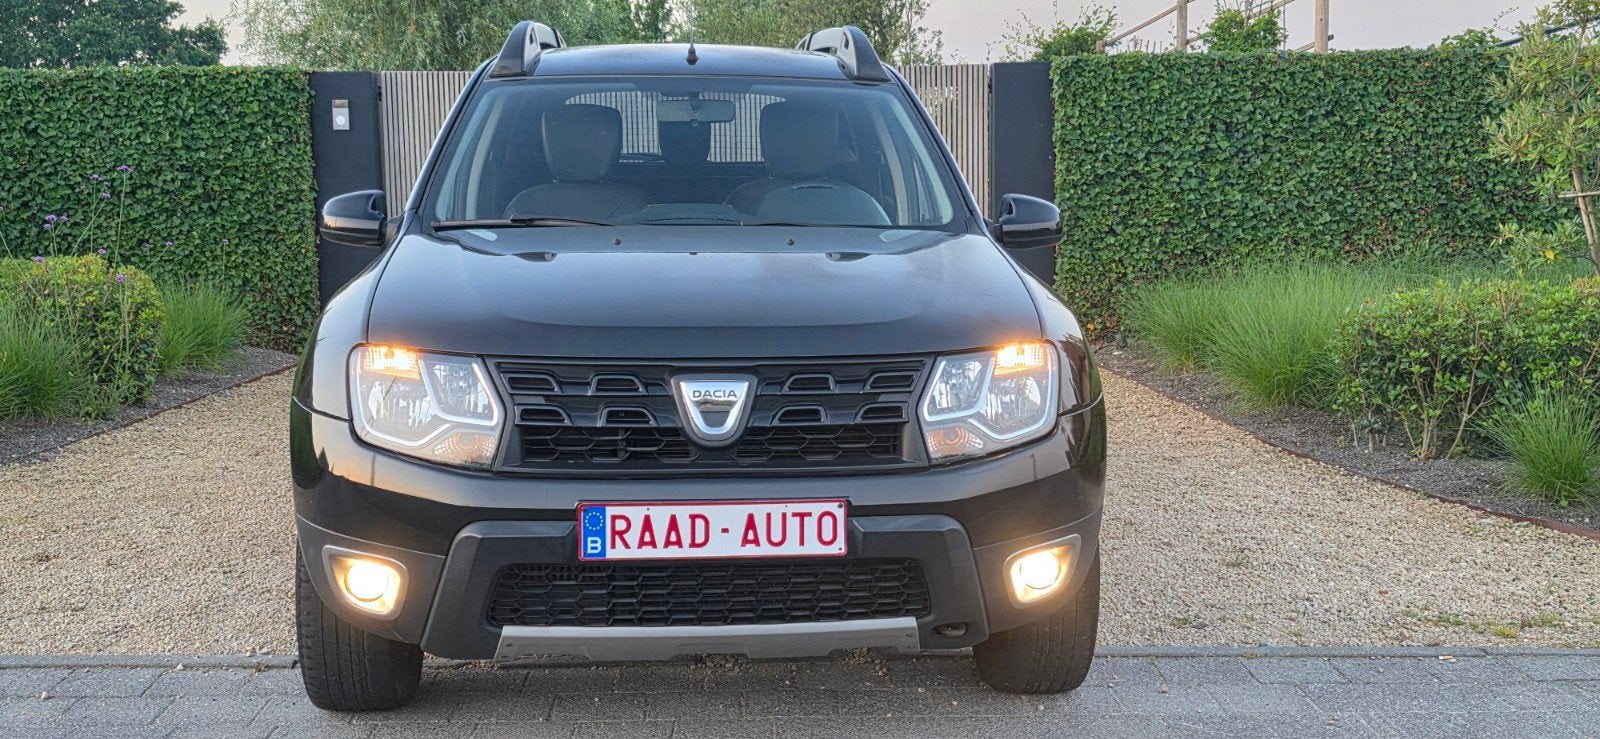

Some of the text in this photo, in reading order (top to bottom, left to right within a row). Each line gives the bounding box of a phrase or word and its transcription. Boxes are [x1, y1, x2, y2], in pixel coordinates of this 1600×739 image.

[692, 390, 738, 398] DACIA
[610, 514, 710, 550] RAAD
[740, 510, 838, 548] AUTO
[586, 537, 602, 554] B
